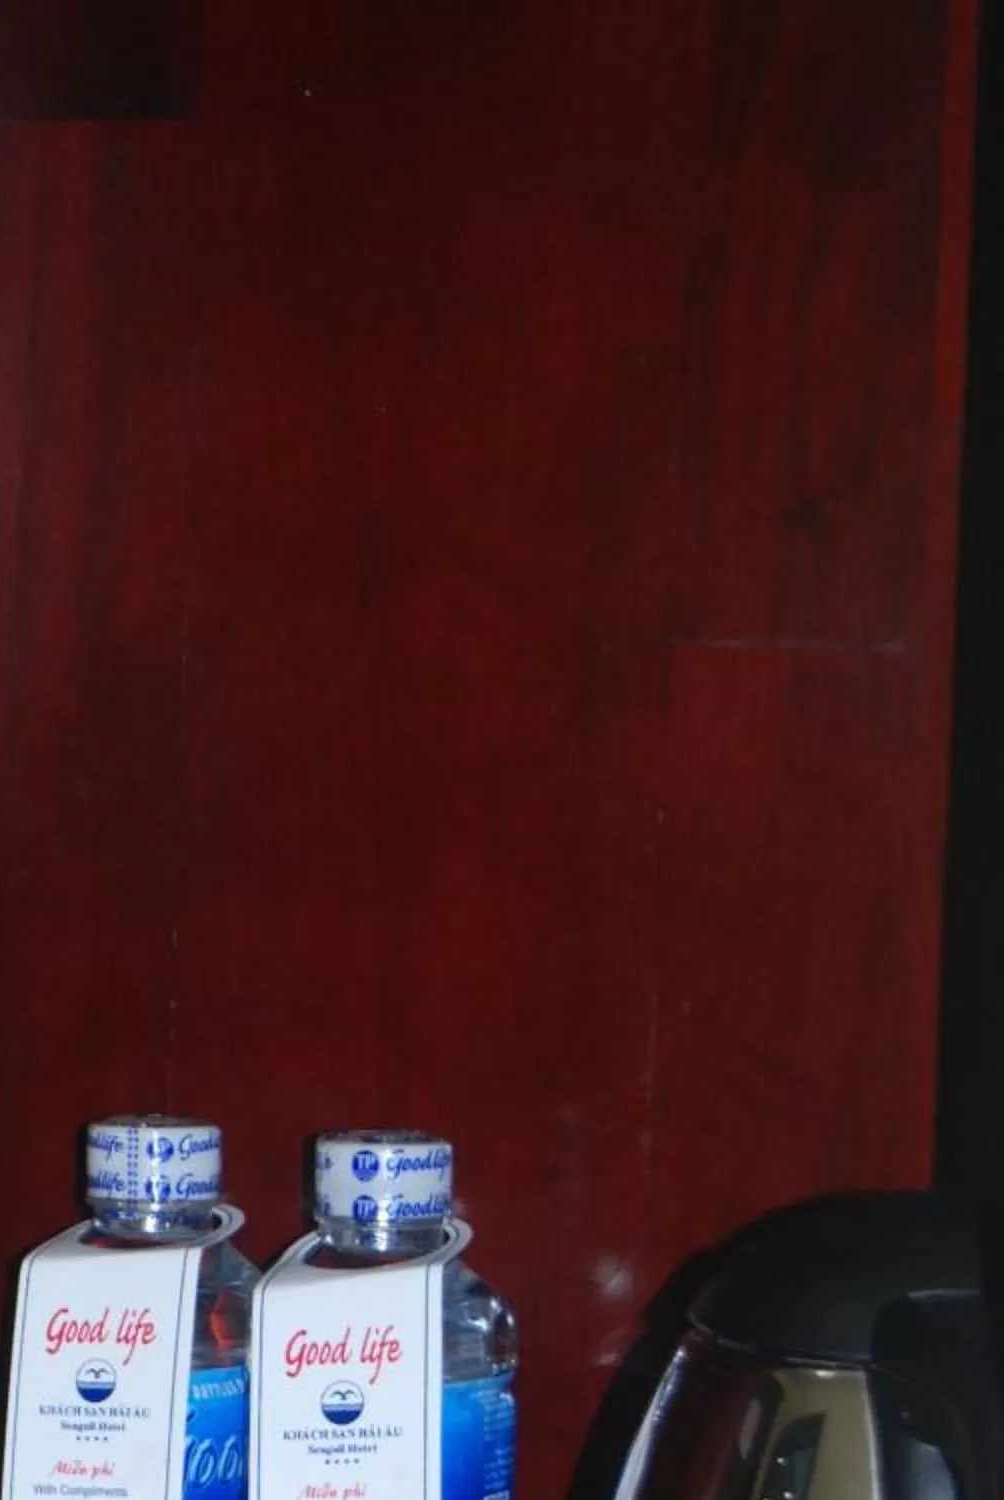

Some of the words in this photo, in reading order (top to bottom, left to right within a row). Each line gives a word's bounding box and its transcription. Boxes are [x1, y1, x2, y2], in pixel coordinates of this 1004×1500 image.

[46, 1306, 109, 1355] Good
[115, 1307, 157, 1366] life
[285, 1326, 353, 1378] Good
[360, 1324, 403, 1385] life
